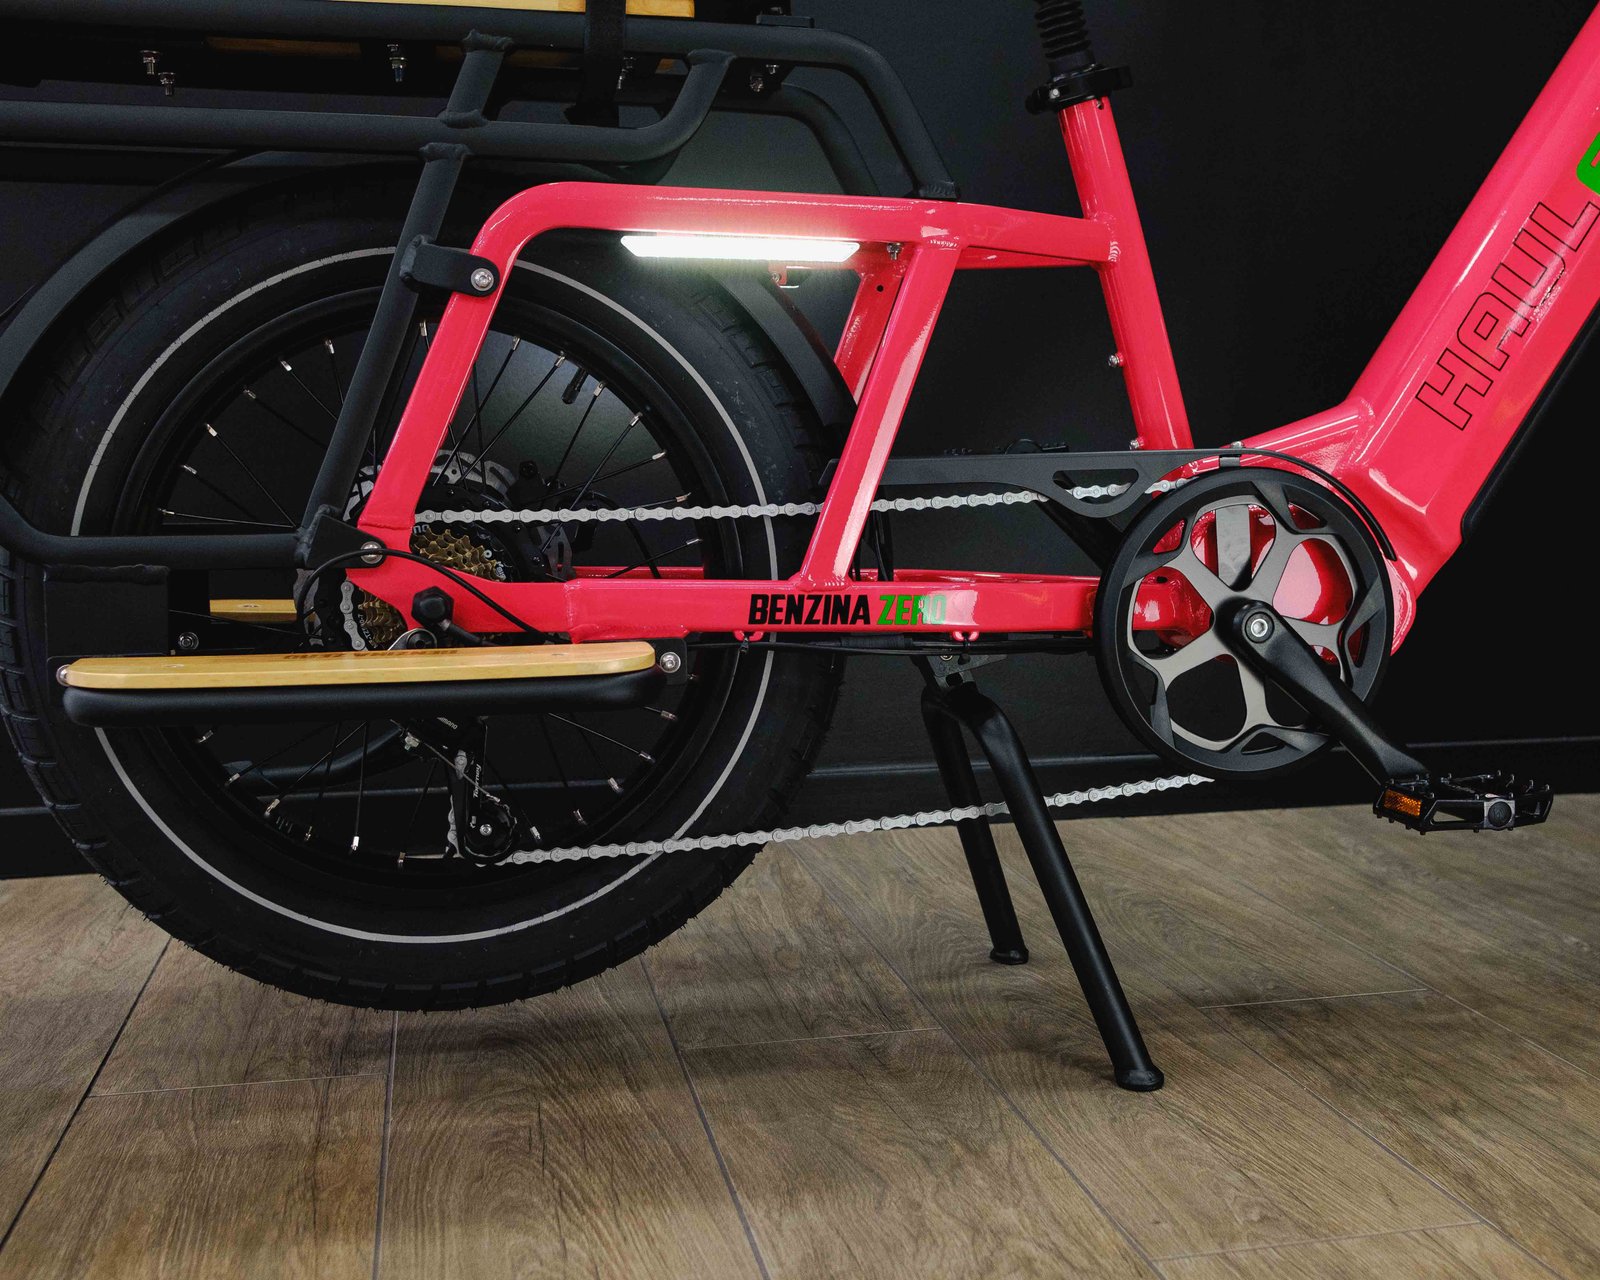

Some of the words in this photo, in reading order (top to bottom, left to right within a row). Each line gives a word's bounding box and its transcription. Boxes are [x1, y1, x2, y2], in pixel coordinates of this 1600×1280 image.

[1415, 201, 1600, 431] HAUL
[748, 593, 871, 625] BENZINA
[877, 594, 947, 625] ZERO
